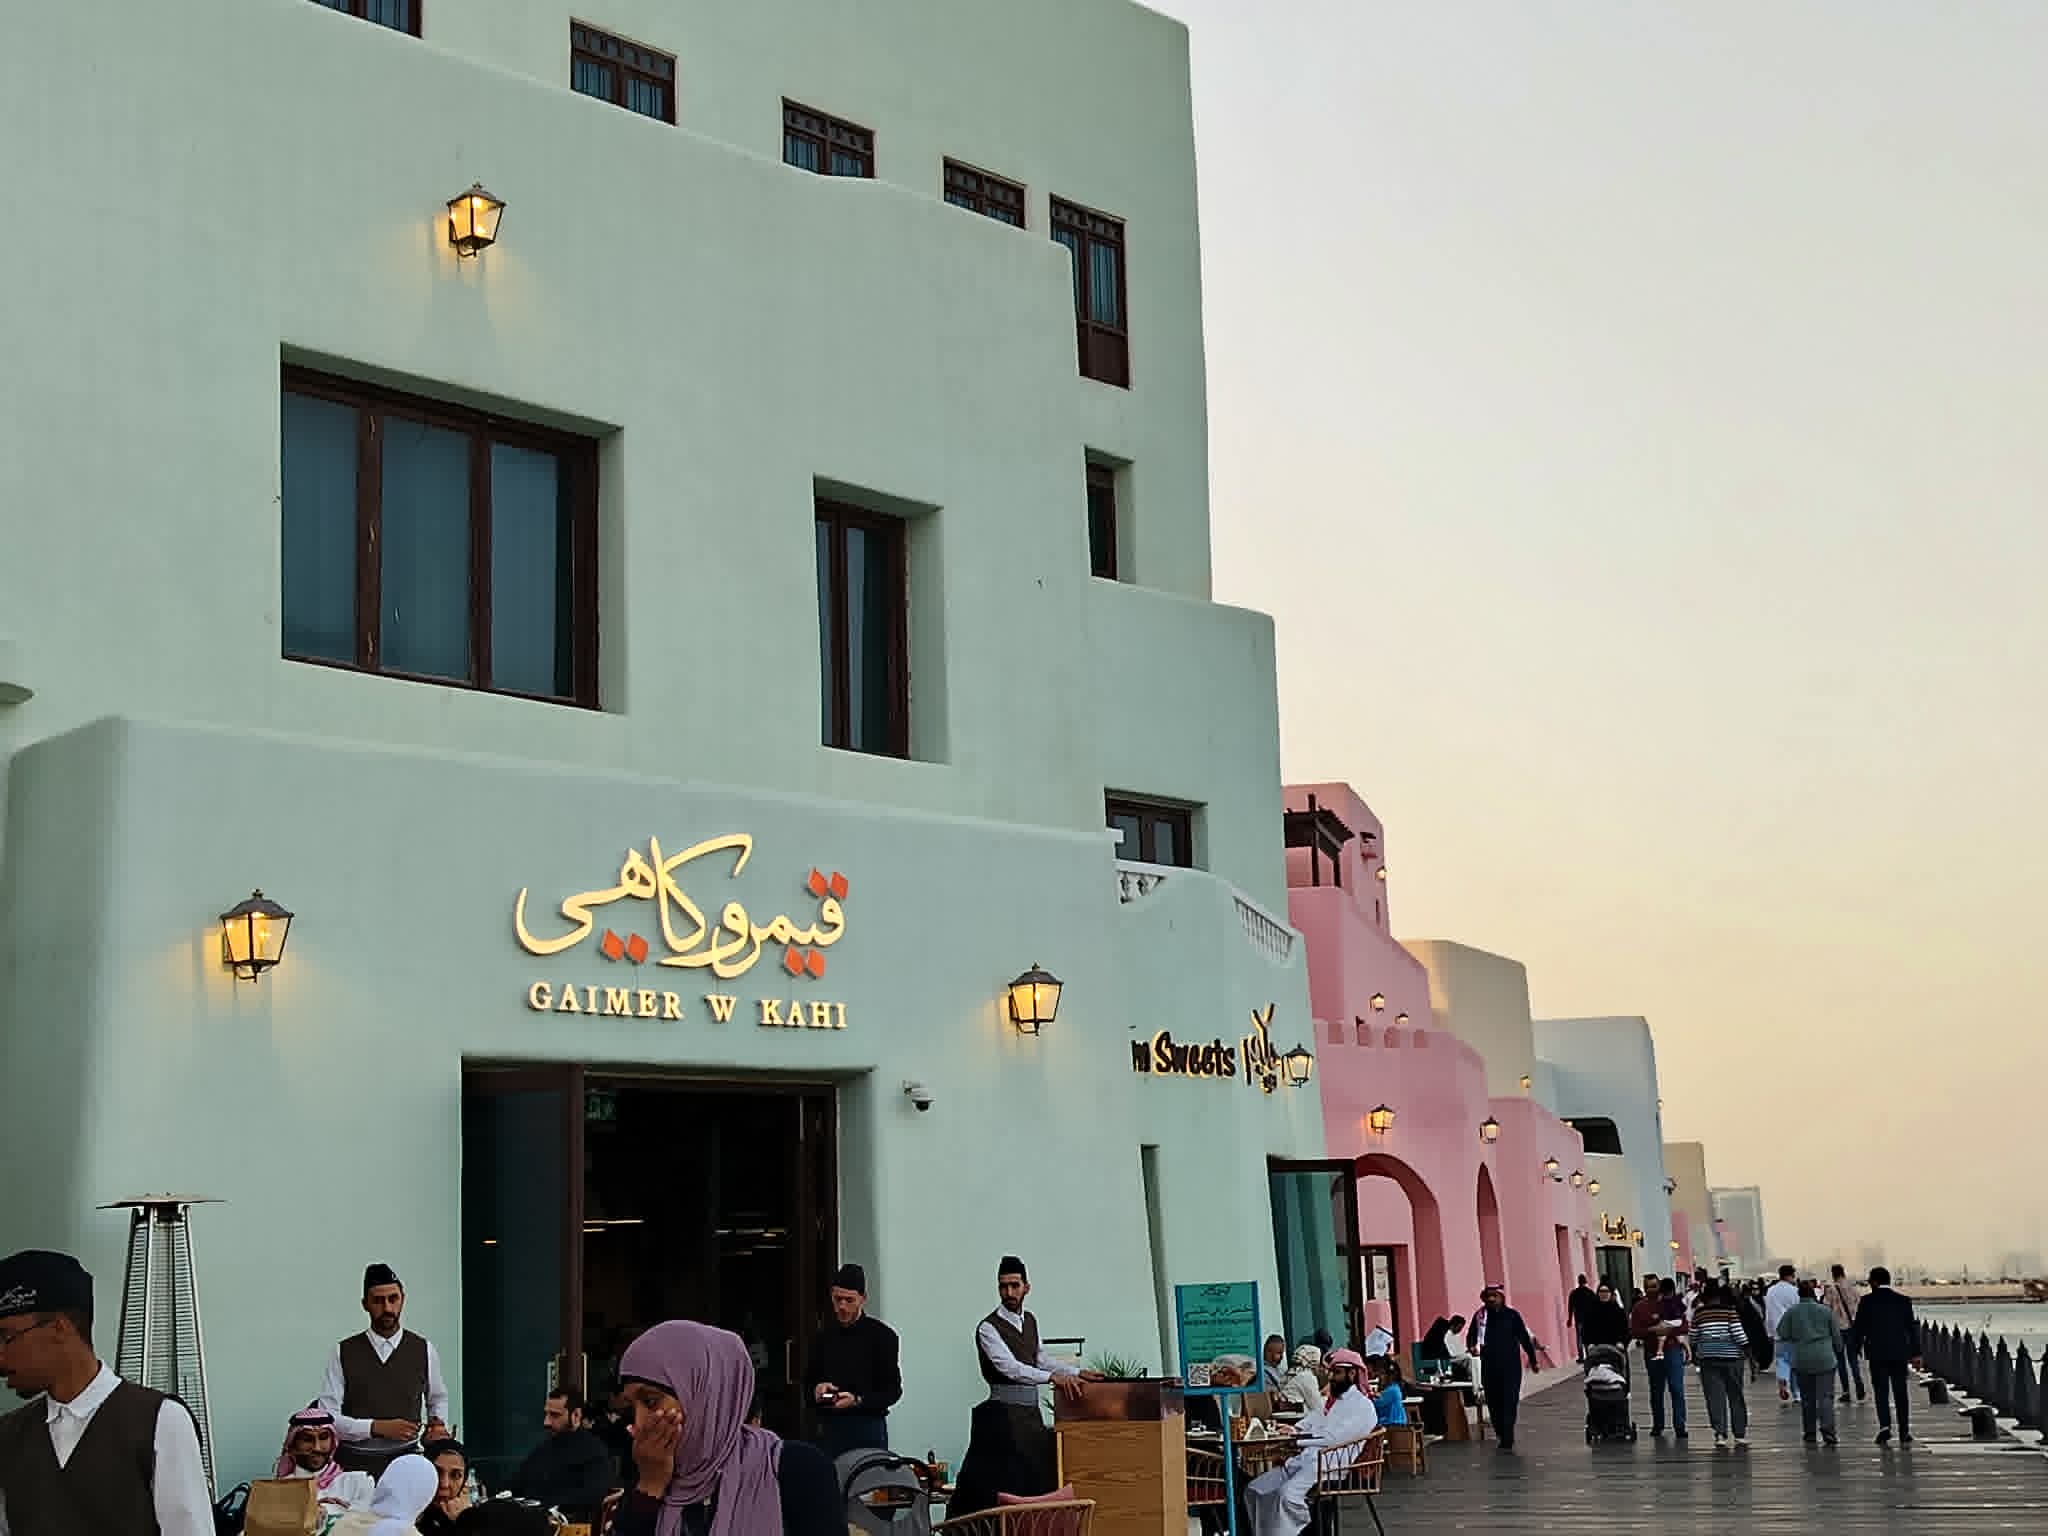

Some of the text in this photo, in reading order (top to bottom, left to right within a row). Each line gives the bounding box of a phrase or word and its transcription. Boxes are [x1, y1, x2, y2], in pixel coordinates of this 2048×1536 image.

[528, 981, 849, 1029] GAIMER W KAHI
[1153, 1030, 1237, 1078] Sweets
